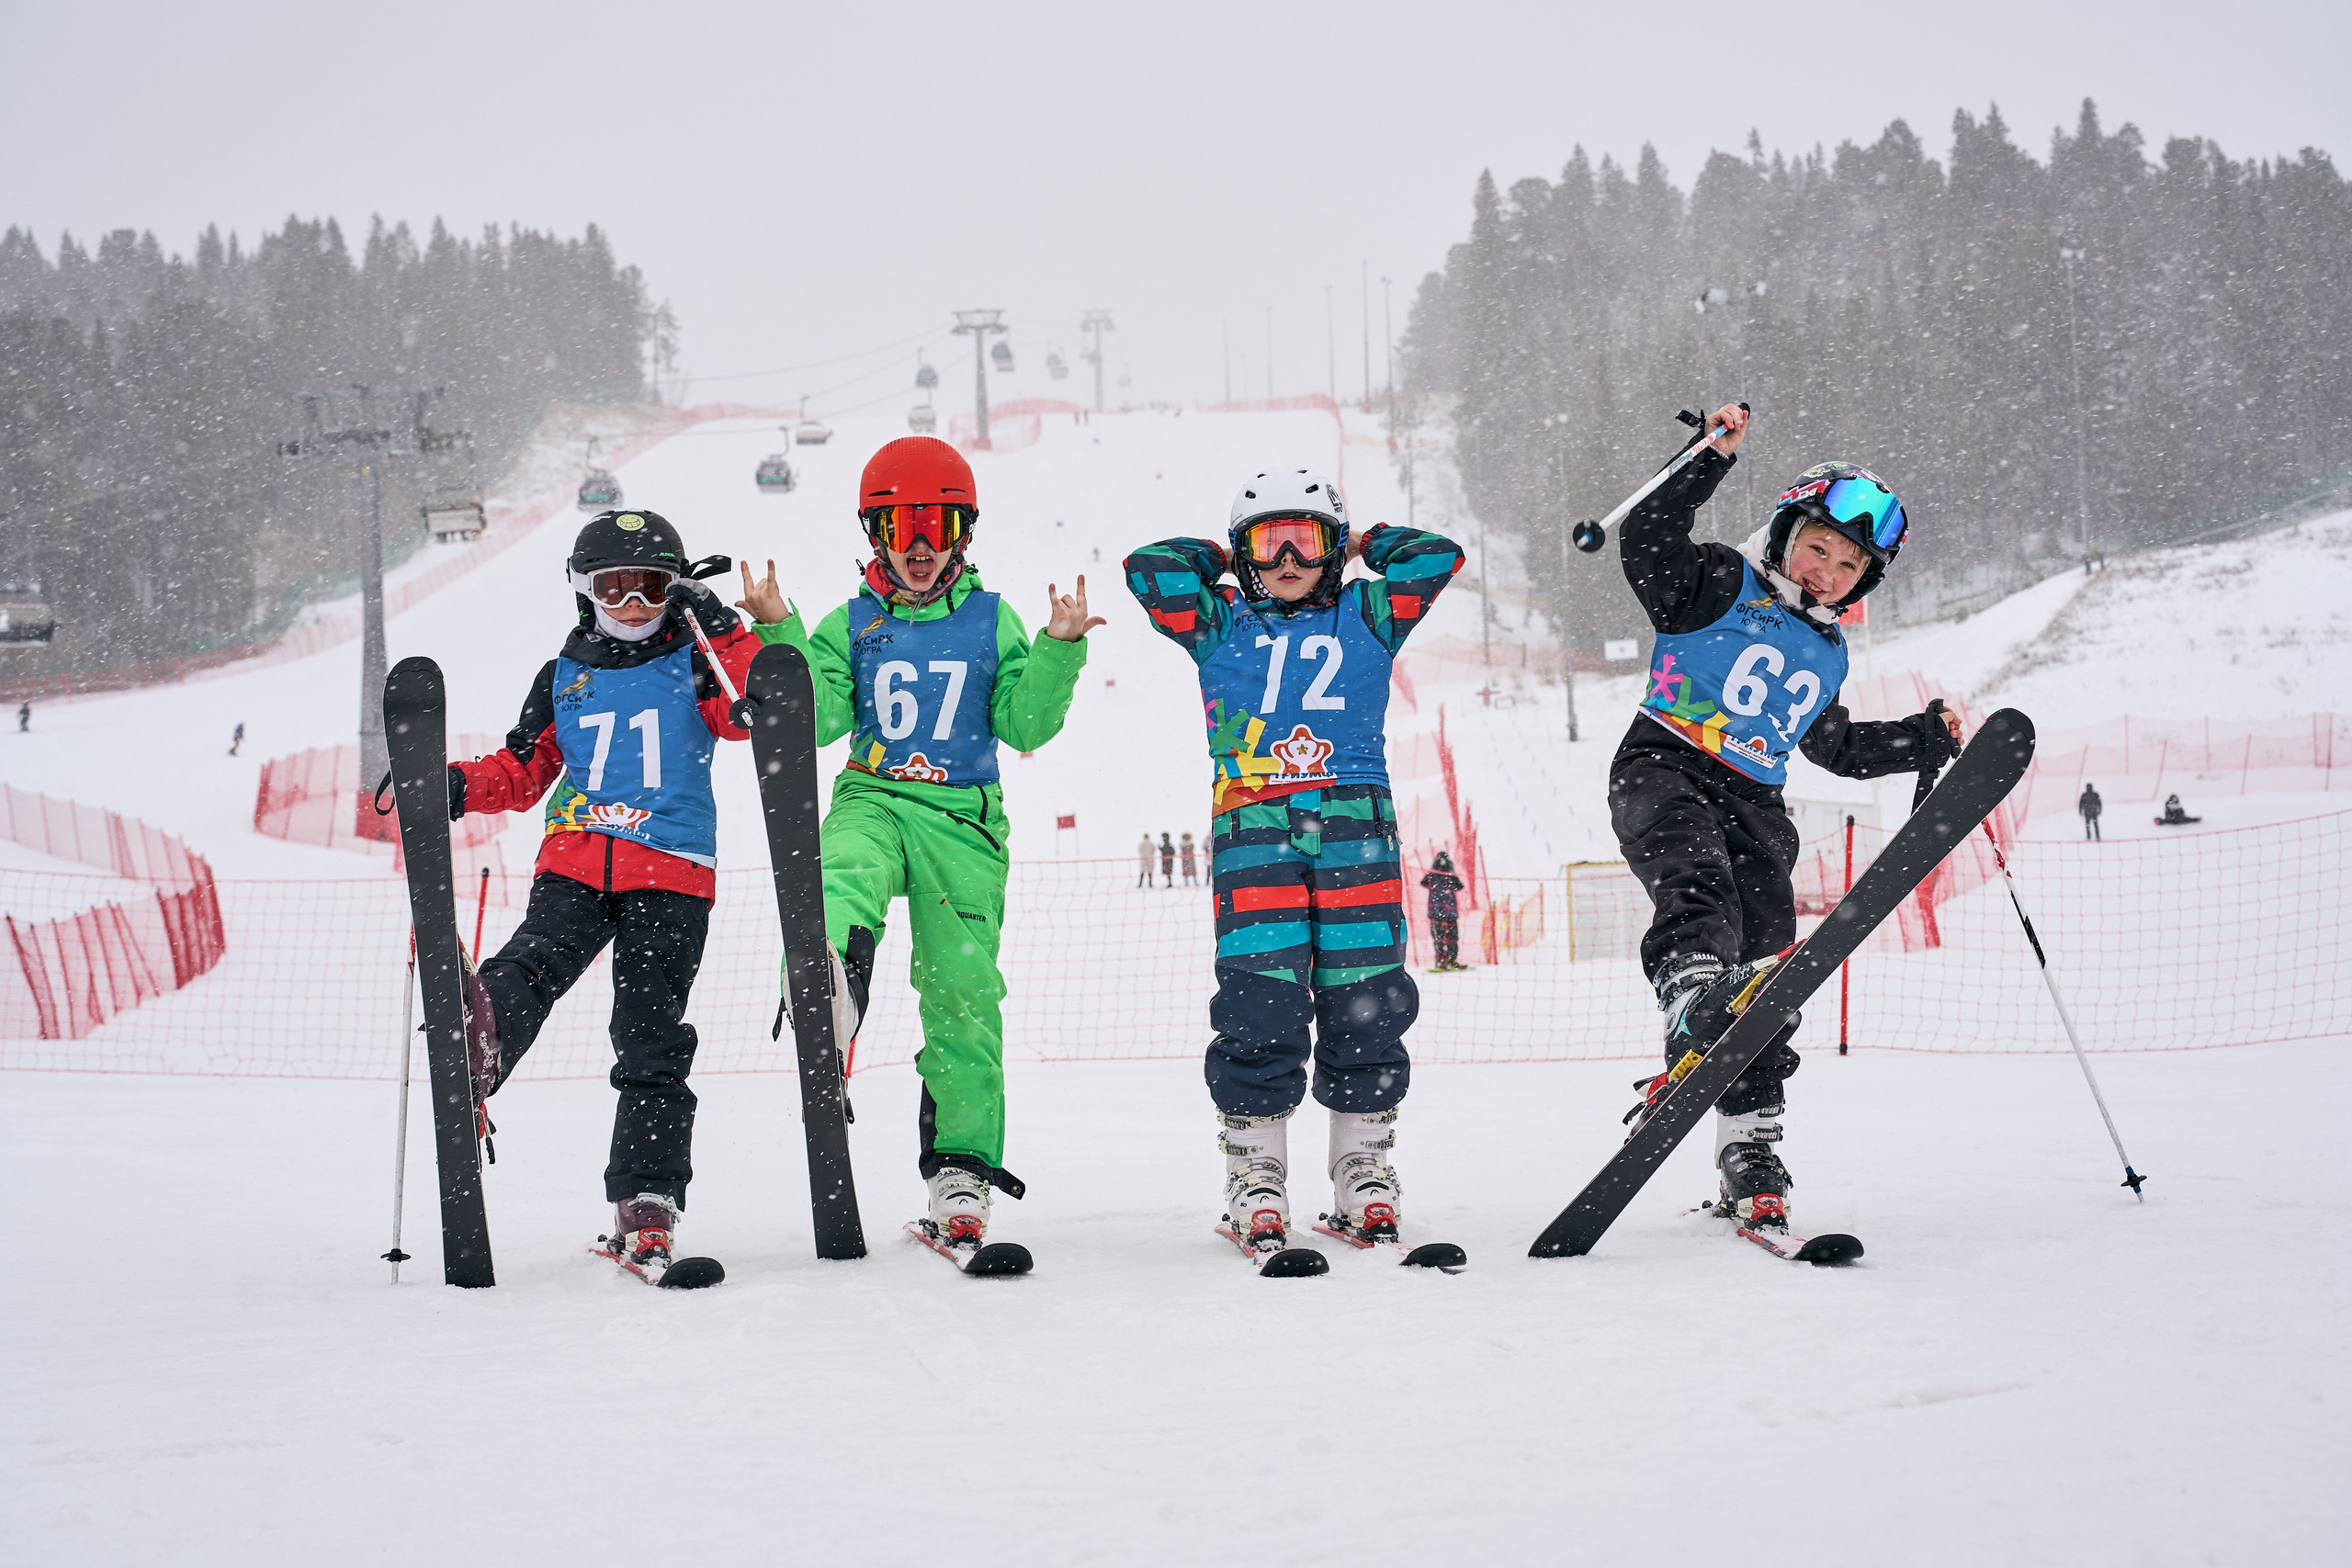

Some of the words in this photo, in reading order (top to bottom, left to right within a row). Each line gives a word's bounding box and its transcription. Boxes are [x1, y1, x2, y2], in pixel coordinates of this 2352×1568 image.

[1736, 603, 1783, 630] ФГСиРК
[1740, 616, 1767, 633] ЮГРА
[554, 691, 595, 705] ФГСиРК
[874, 660, 967, 741] 67
[1255, 634, 1345, 715] 72
[1722, 643, 1821, 743] 63
[579, 708, 662, 791] 71
